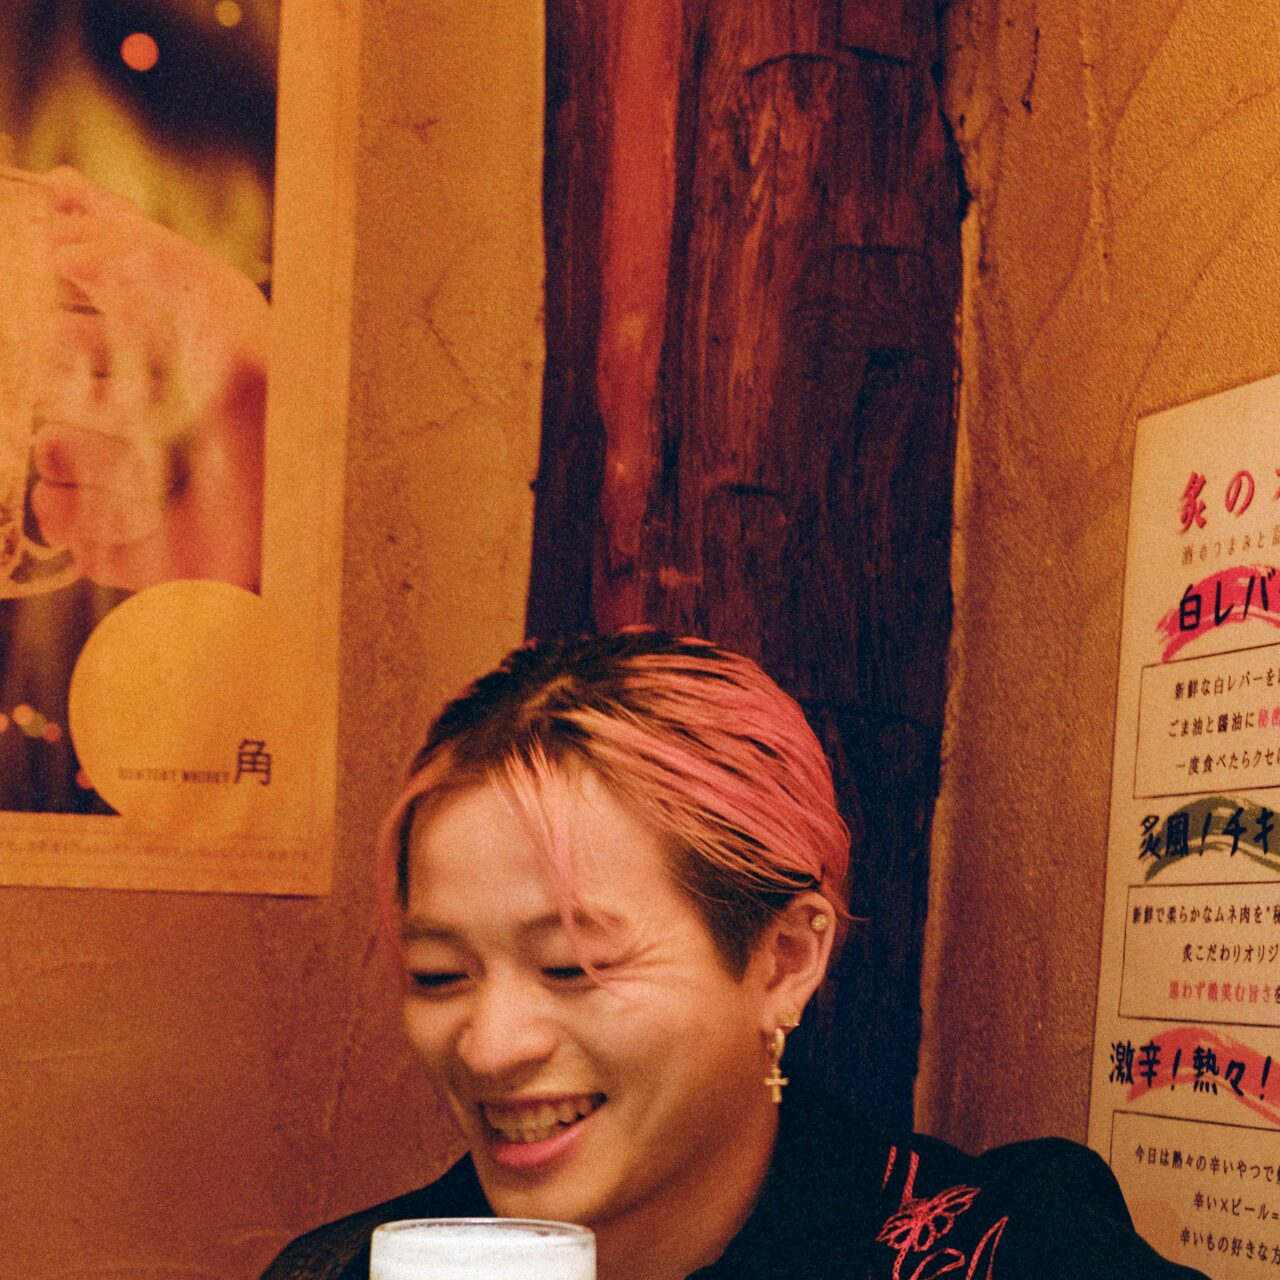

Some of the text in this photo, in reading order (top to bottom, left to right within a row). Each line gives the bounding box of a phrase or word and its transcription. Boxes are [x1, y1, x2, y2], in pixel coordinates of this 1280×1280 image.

[1179, 468, 1280, 536] 炙の
[1179, 567, 1280, 632] 白レバ
[1174, 667, 1280, 700] 新鮮な白レバーを
[233, 738, 273, 786] 角
